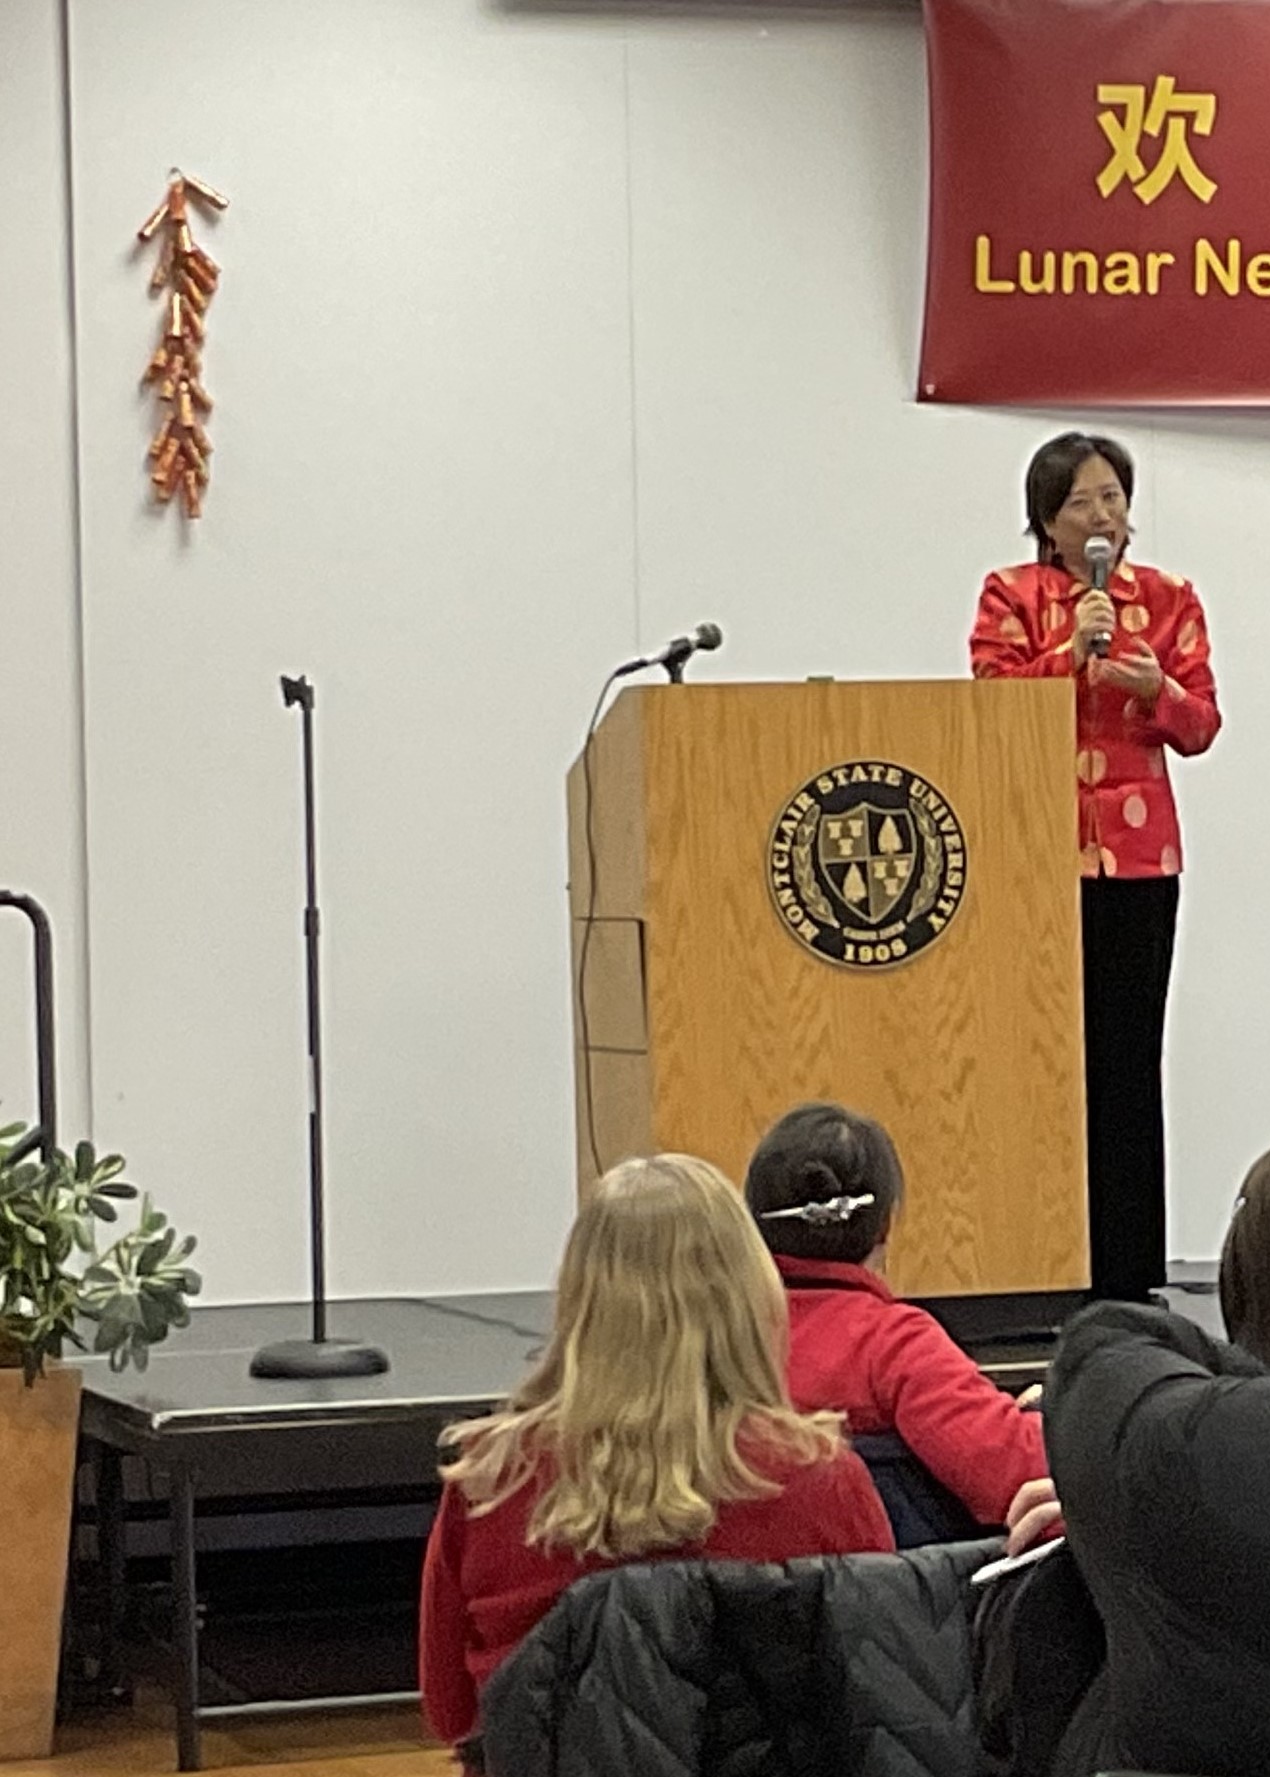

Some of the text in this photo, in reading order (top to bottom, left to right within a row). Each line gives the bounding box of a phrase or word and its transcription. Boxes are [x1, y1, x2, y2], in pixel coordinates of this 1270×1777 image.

[975, 234, 1175, 296] Lunar
[773, 765, 963, 942] MONTCLAIR STATE UNIVERSITY
